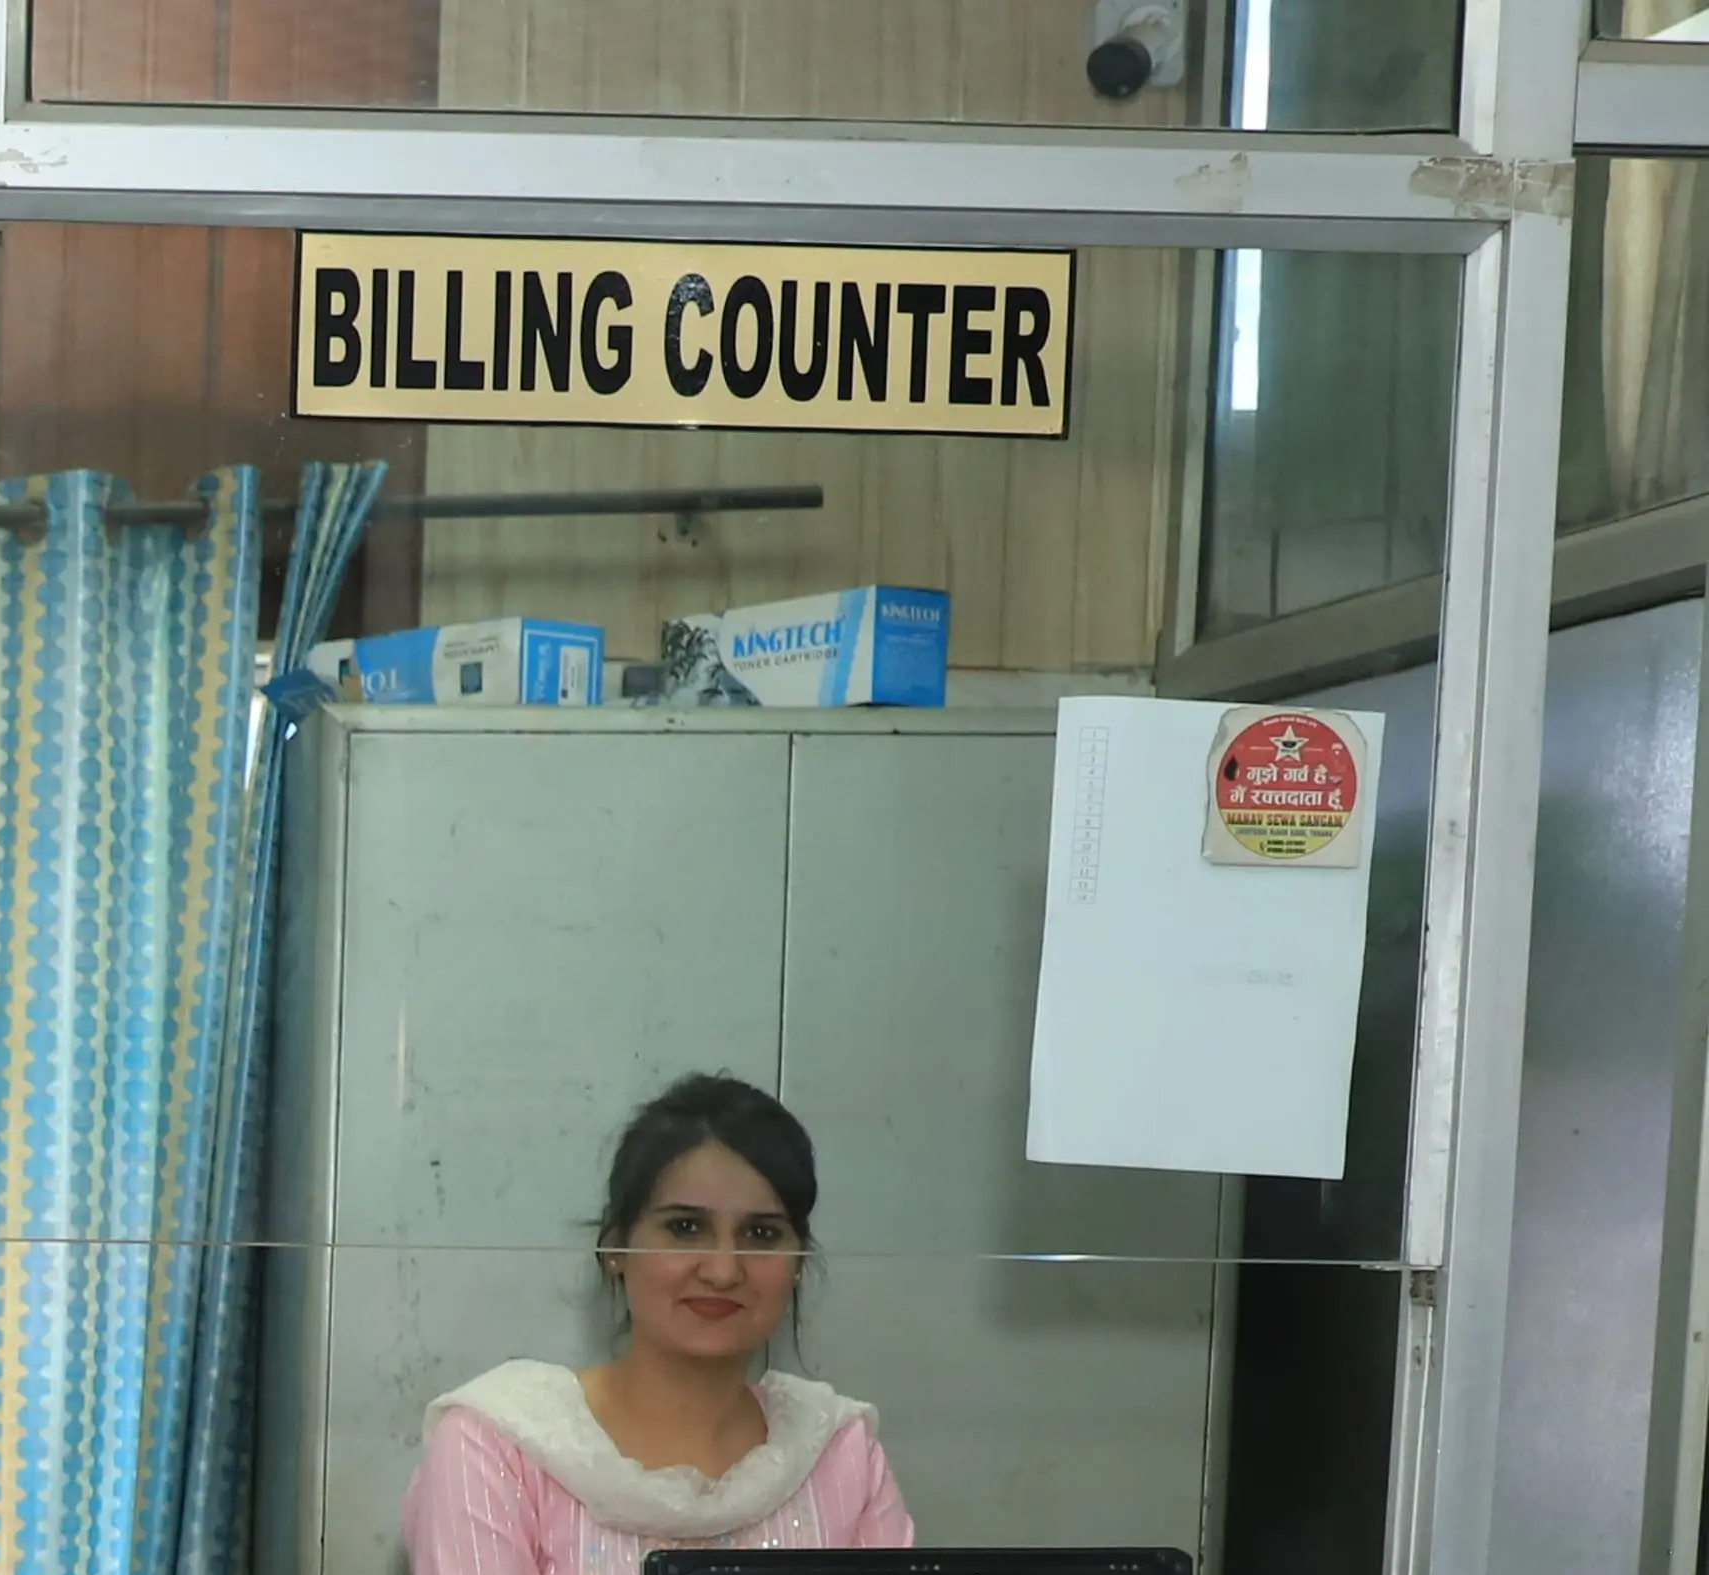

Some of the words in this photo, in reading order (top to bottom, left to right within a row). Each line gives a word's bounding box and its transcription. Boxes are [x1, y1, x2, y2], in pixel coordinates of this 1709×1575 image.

[312, 267, 635, 395] BILLING
[664, 273, 1051, 407] COUNTER
[733, 618, 842, 659] KINGTECH
